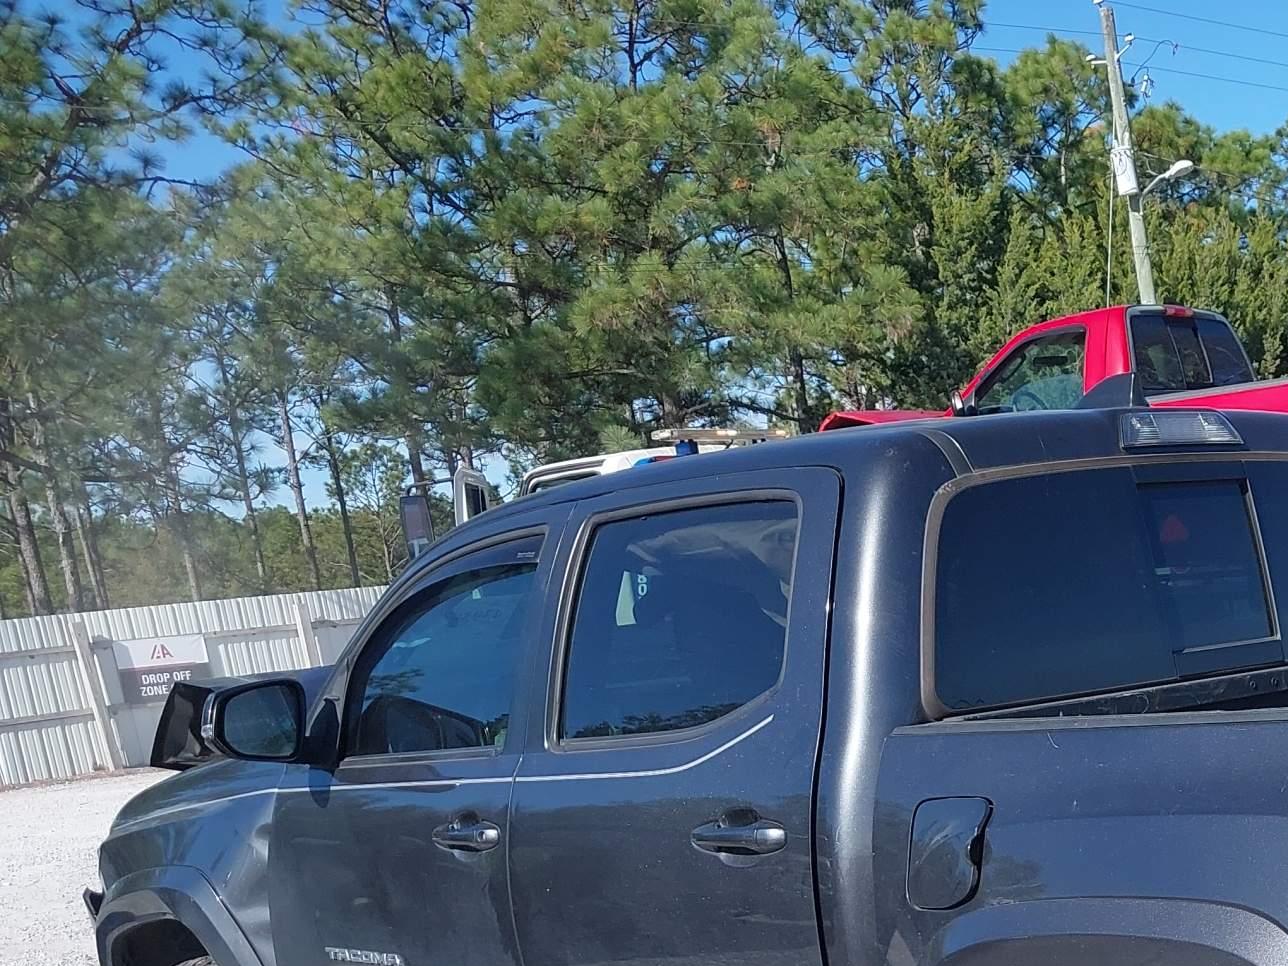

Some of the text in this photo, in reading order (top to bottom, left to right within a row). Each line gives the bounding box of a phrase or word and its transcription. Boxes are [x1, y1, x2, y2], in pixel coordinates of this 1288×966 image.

[141, 670, 192, 685] DROP OFF
[140, 684, 169, 697] ZONE
